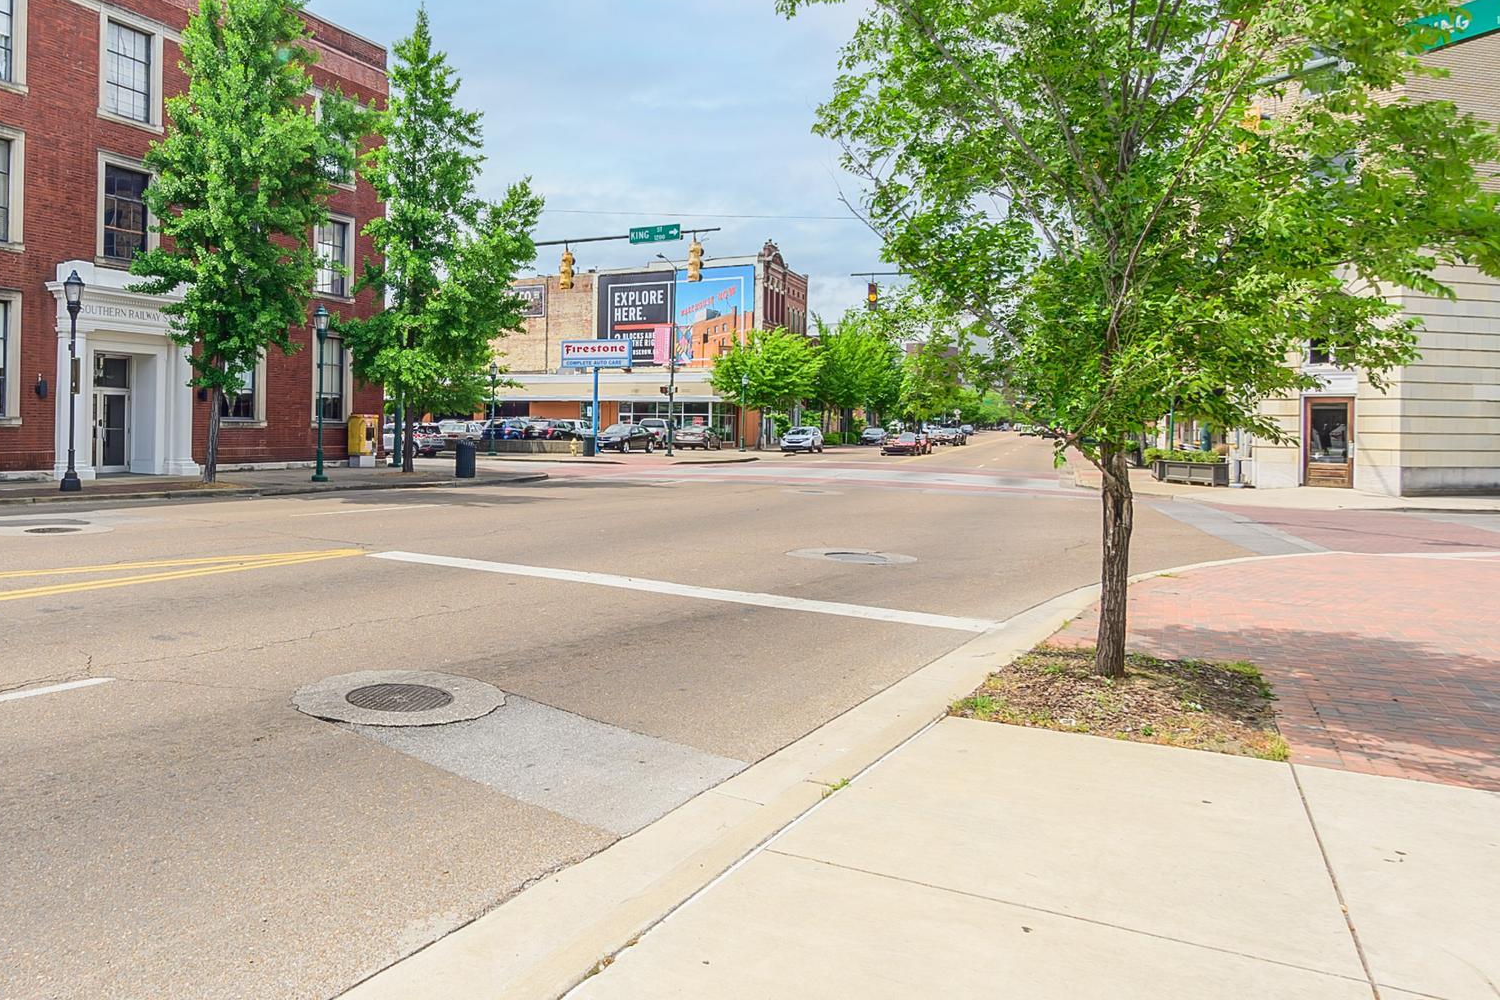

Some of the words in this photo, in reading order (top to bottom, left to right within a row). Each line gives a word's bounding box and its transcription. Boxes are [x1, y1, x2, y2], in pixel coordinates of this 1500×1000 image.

[630, 230, 650, 240] KING
[614, 289, 665, 306] EXPLORE
[79, 303, 127, 318] SOUTHERN
[128, 309, 161, 321] RAILWAY
[614, 307, 647, 322] HERE.
[564, 344, 626, 355] Firestone
